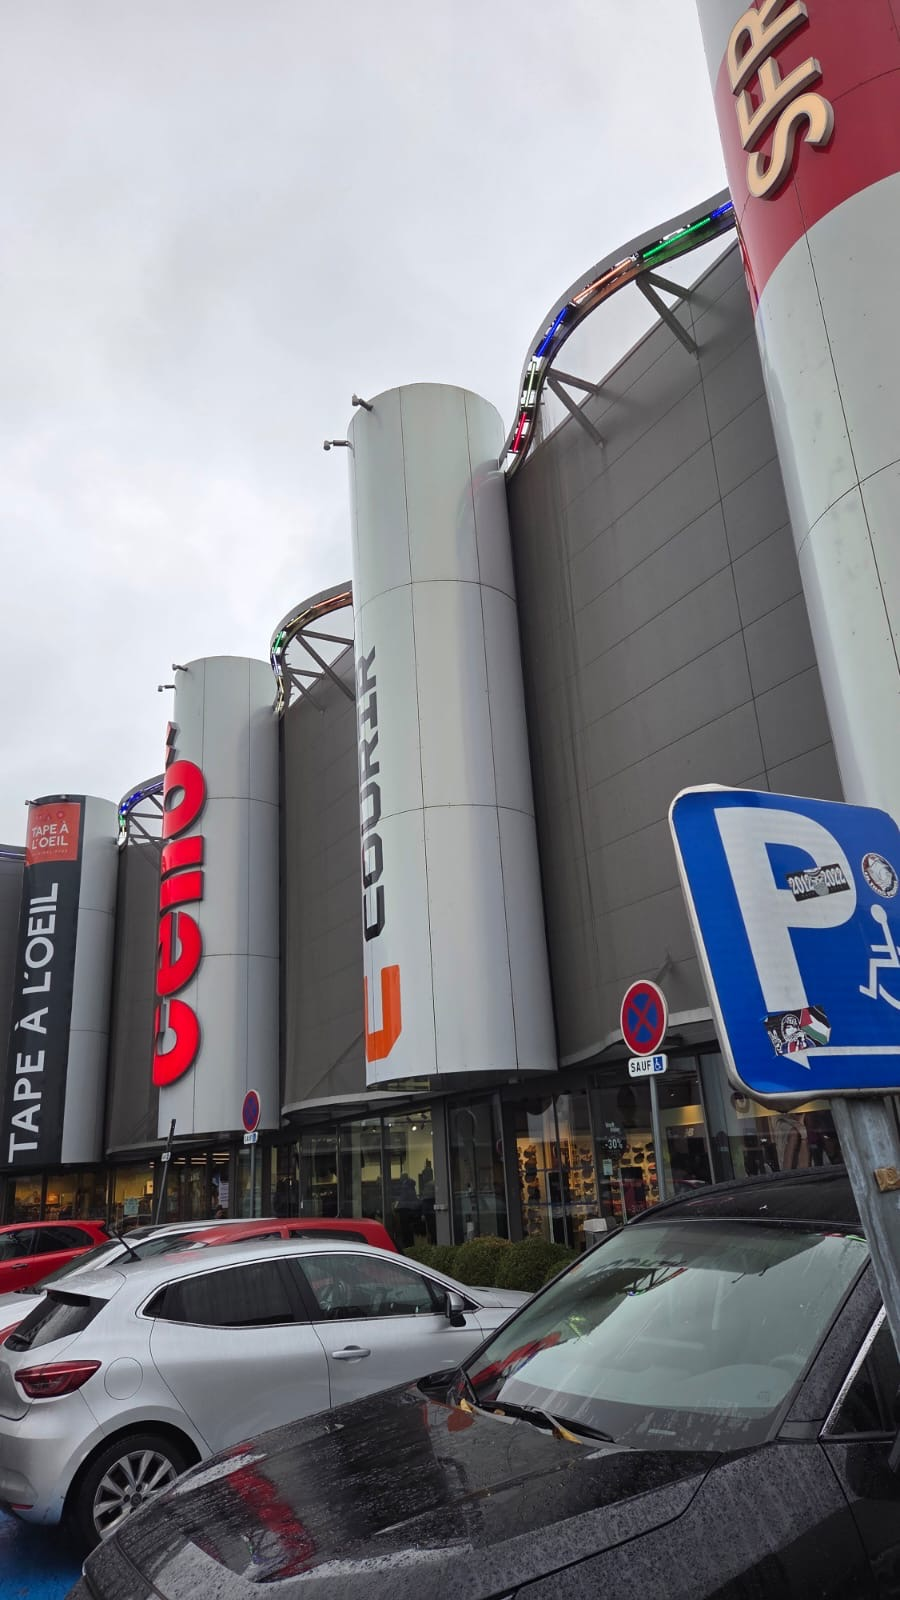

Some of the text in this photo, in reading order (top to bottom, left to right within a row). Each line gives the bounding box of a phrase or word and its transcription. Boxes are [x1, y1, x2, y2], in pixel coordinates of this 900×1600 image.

[727, 0, 834, 200] SFR
[356, 645, 385, 942] COURIR
[32, 820, 69, 837] TAPE À
[32, 836, 69, 850] L'OEIL
[787, 874, 815, 894] 2012
[820, 867, 847, 887] 2022
[22, 882, 59, 994] L'OEIL
[14, 1006, 50, 1034] À
[631, 1060, 652, 1073] SAUF
[8, 1050, 45, 1163] TAPE
